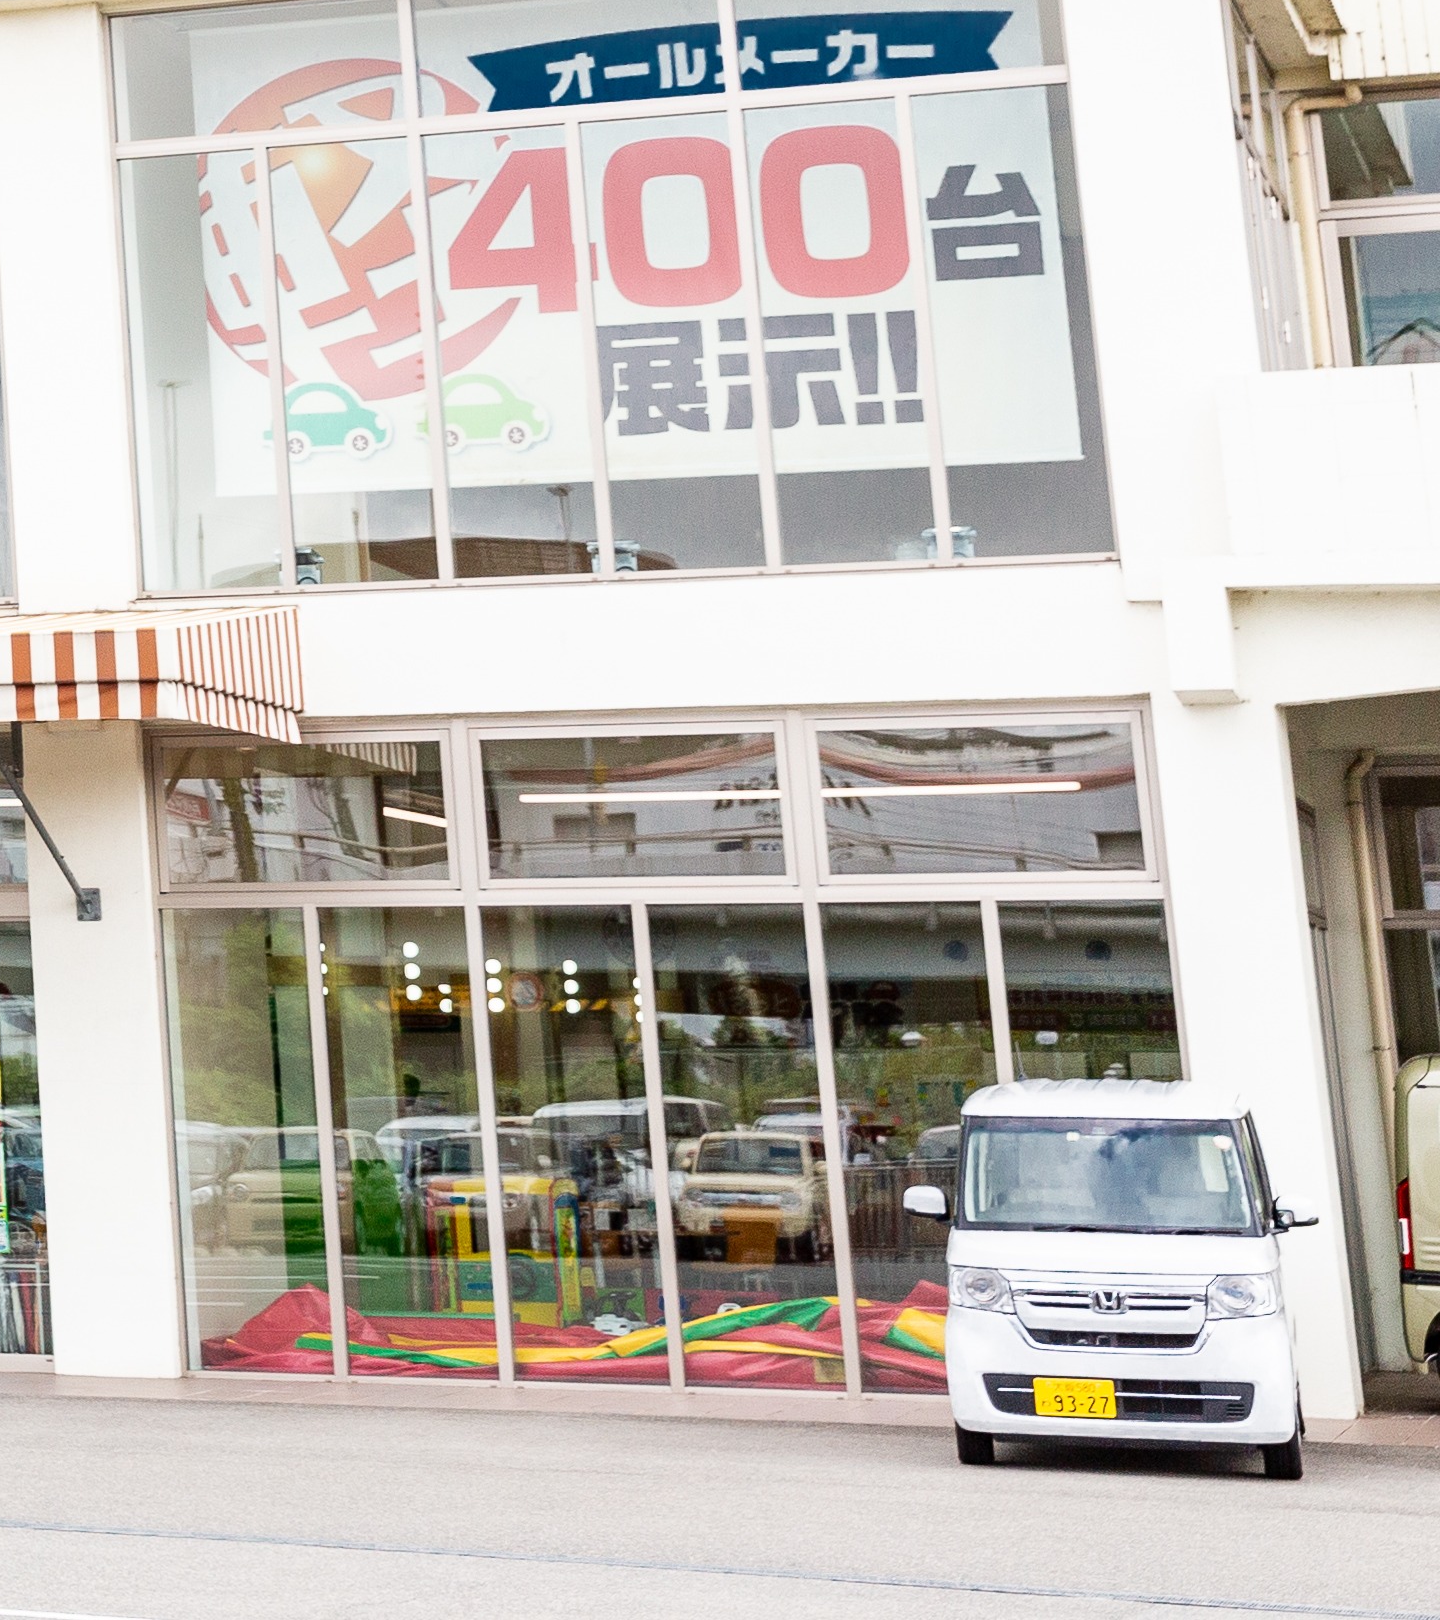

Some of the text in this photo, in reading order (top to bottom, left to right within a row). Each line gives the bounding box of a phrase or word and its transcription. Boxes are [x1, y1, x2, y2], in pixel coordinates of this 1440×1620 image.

[546, 25, 936, 103] オールメーカー
[1054, 1395, 1109, 1414] 93-27
